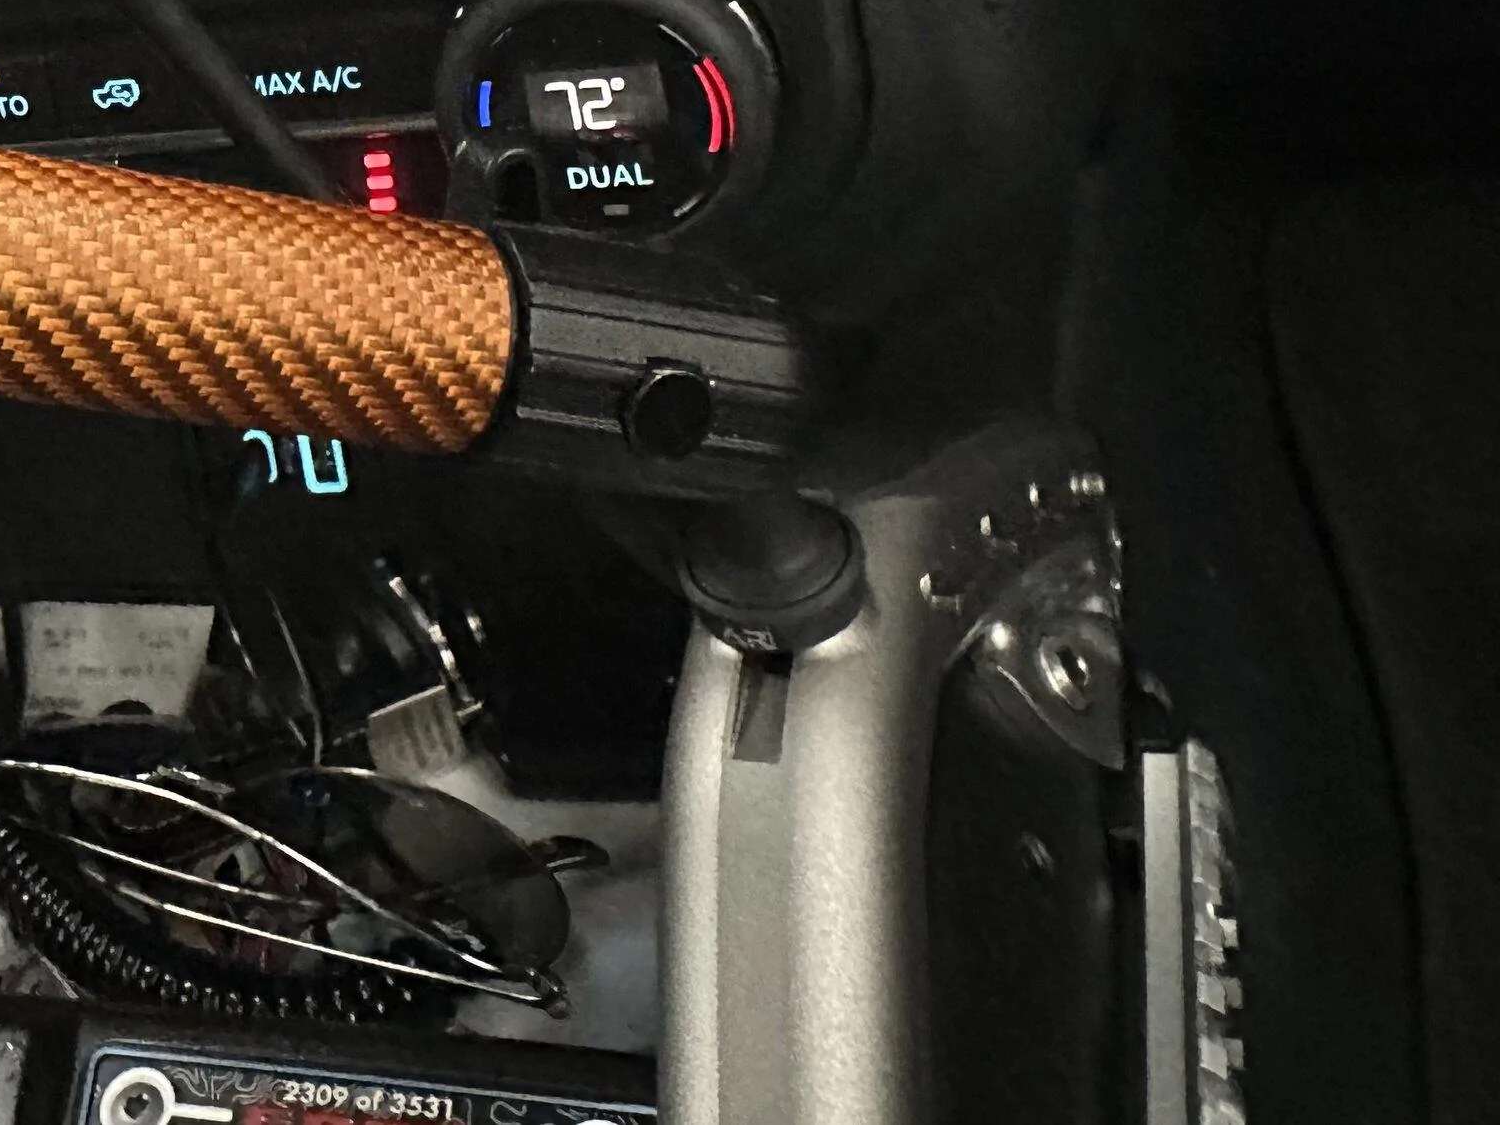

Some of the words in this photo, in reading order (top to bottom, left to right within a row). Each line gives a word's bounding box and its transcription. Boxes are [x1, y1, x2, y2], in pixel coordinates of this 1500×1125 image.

[312, 65, 362, 93] A/C
[566, 162, 654, 190] DUAL
[283, 1080, 349, 1107] 2309
[355, 1089, 384, 1111] of
[389, 1092, 453, 1120] 3531
